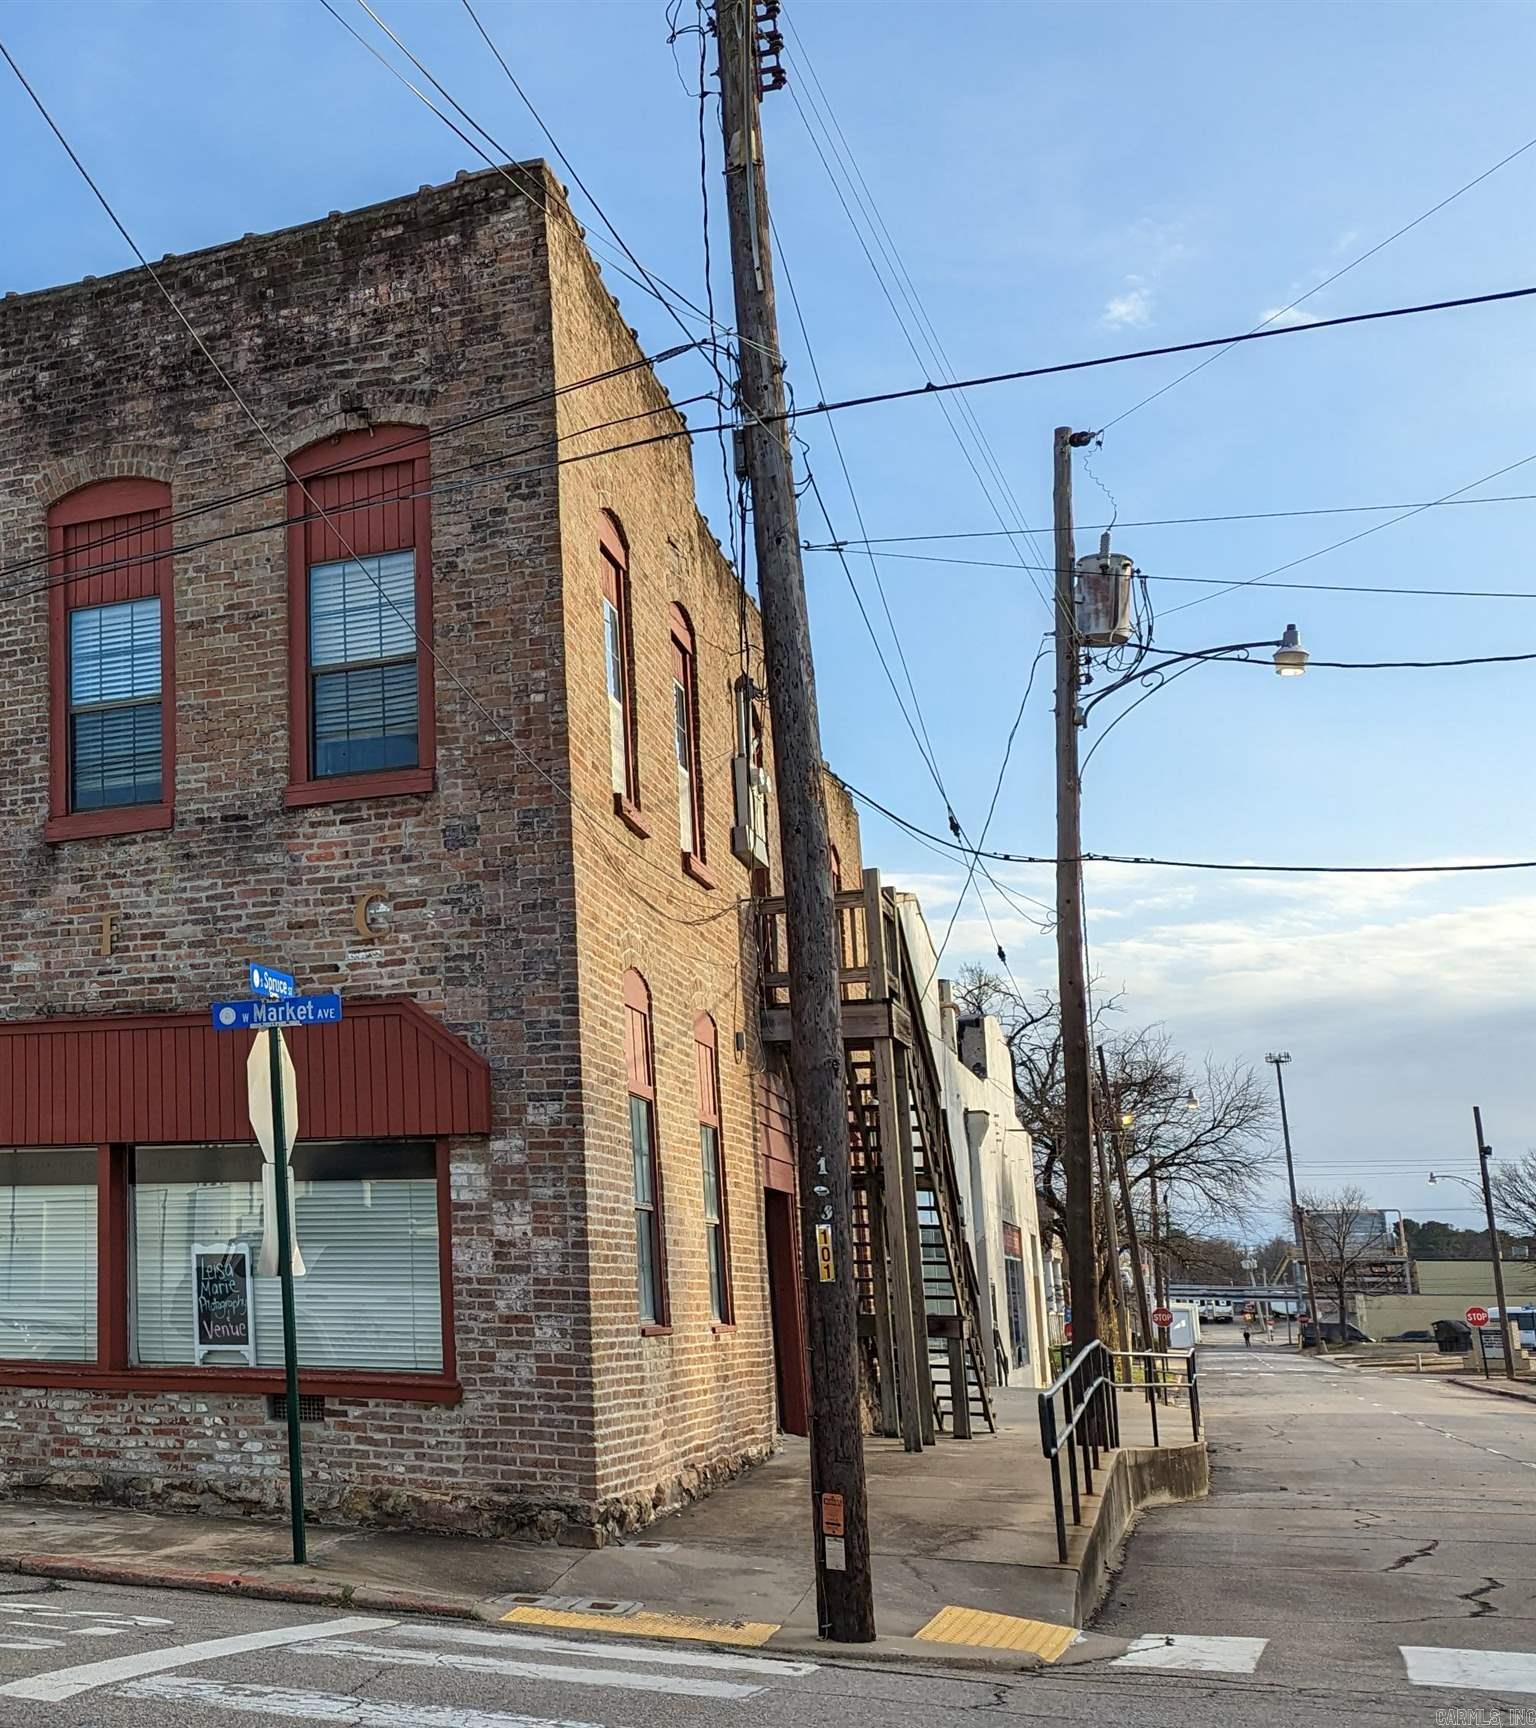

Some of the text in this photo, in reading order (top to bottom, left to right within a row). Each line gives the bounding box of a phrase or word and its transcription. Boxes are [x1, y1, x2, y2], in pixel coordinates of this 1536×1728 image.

[100, 911, 121, 956] F
[355, 889, 390, 937] C
[263, 971, 288, 995] Spruce
[242, 1000, 335, 1023] W Market AVE
[818, 1228, 832, 1280] 101
[201, 1256, 234, 1281] Leisa
[200, 1279, 240, 1297] Marie
[199, 1295, 247, 1320] Photography
[1153, 1313, 1172, 1322] STOP
[1467, 1313, 1488, 1321] STOP
[202, 1319, 247, 1340] Venue
